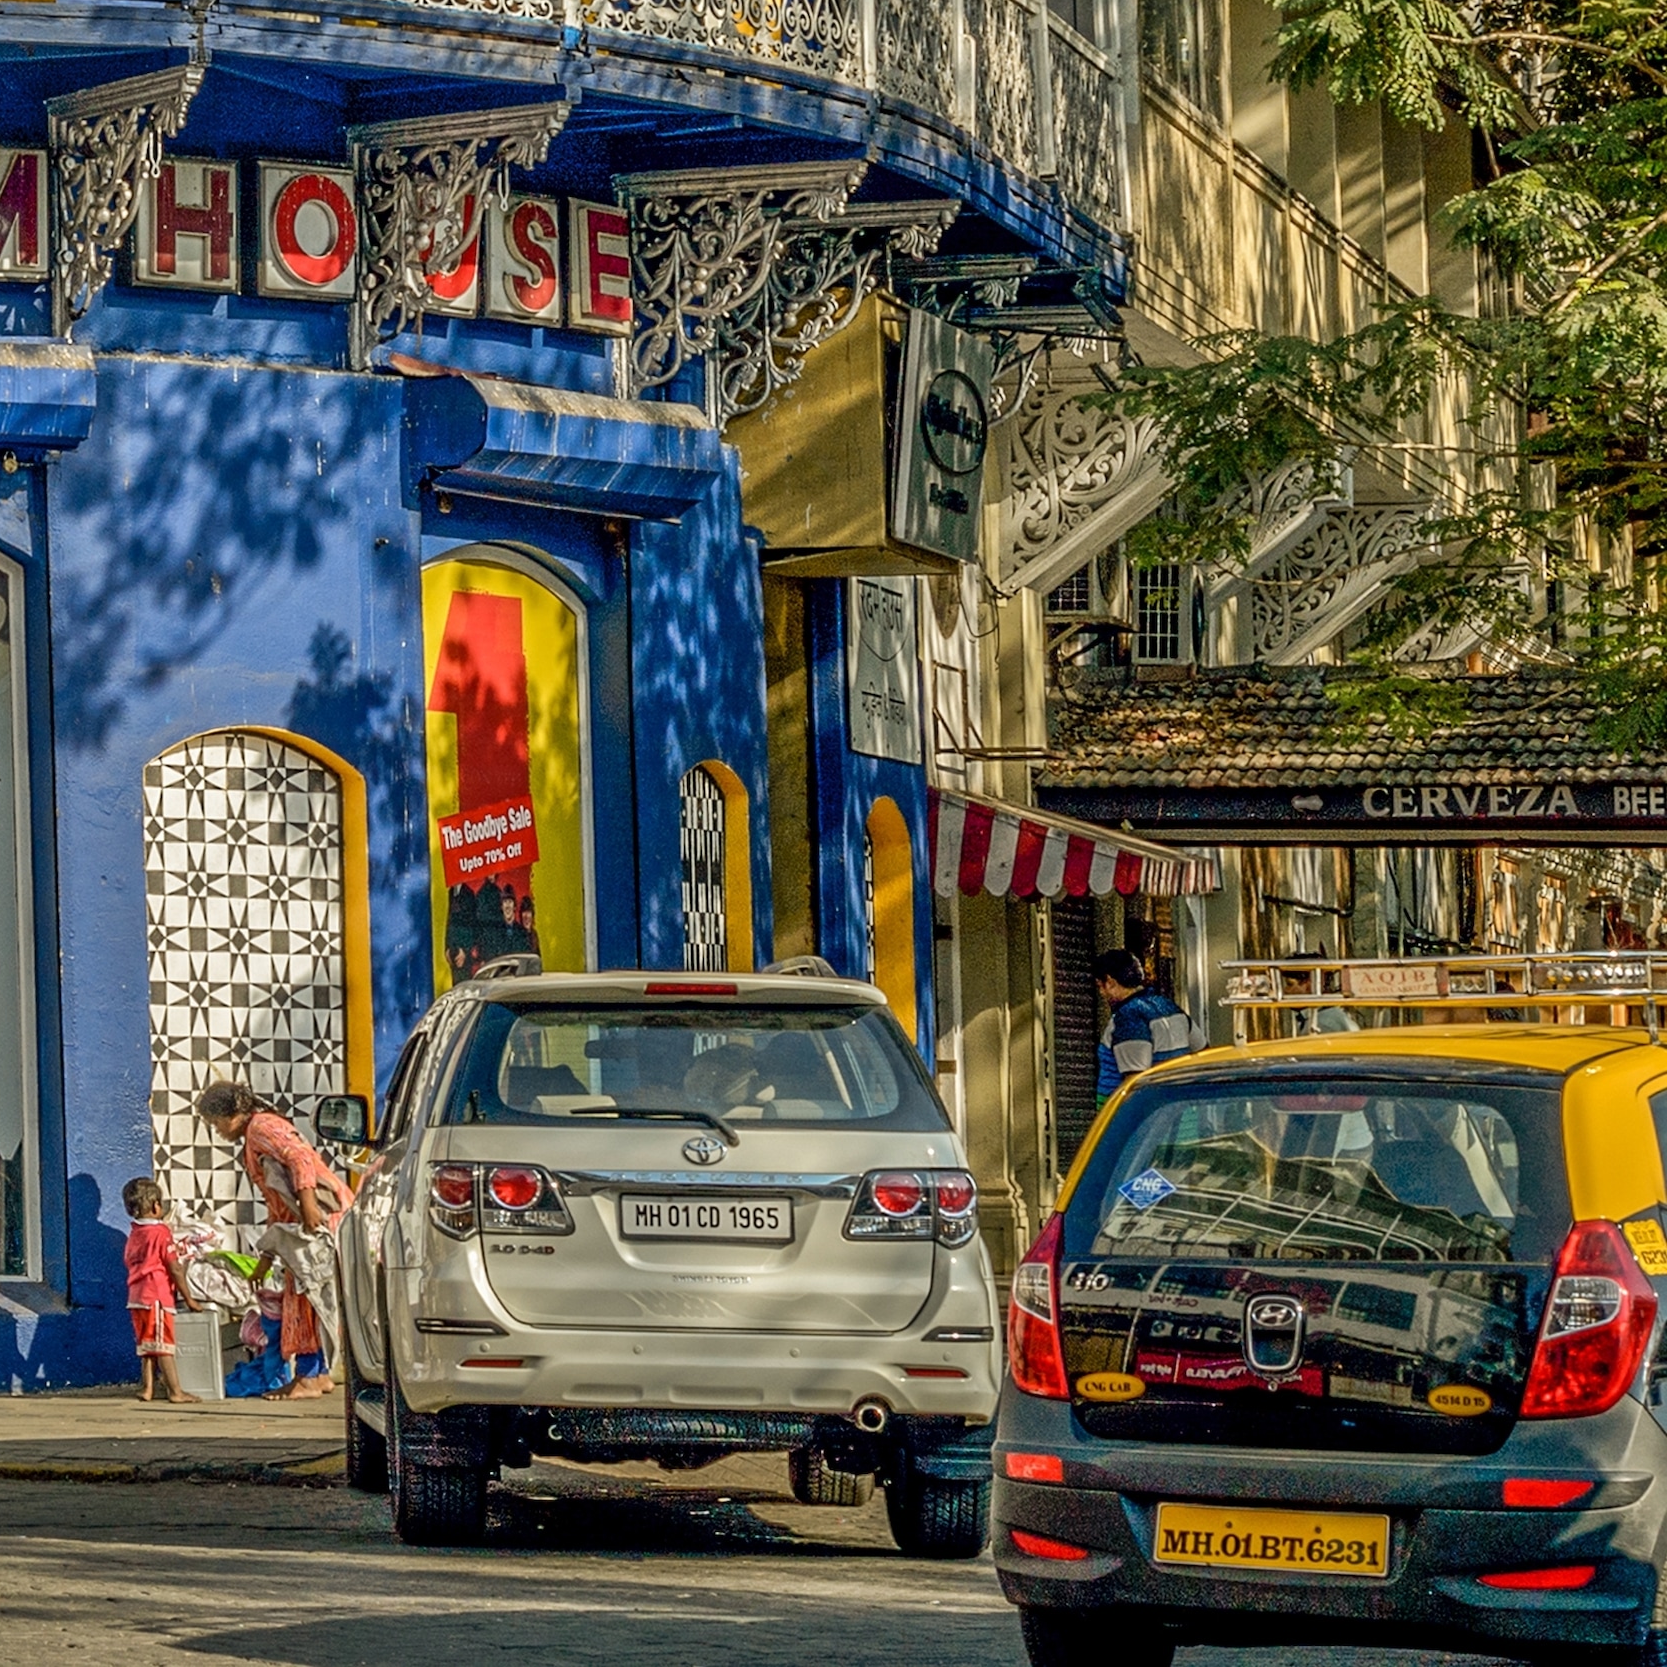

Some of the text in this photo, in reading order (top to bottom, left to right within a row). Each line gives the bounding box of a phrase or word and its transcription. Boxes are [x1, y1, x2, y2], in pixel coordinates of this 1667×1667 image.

[155, 165, 634, 320] HOUSE
[1362, 785, 1581, 817] CERVEZA
[441, 805, 532, 850] The Goodbye Sale
[459, 842, 522, 872] Upto 70% Off
[1132, 1177, 1162, 1191] CNG
[635, 1204, 779, 1229] MH 01 CD 1965
[1085, 1382, 1131, 1392] CNG CAB
[1161, 1529, 1379, 1566] MH.01.BT.6231
